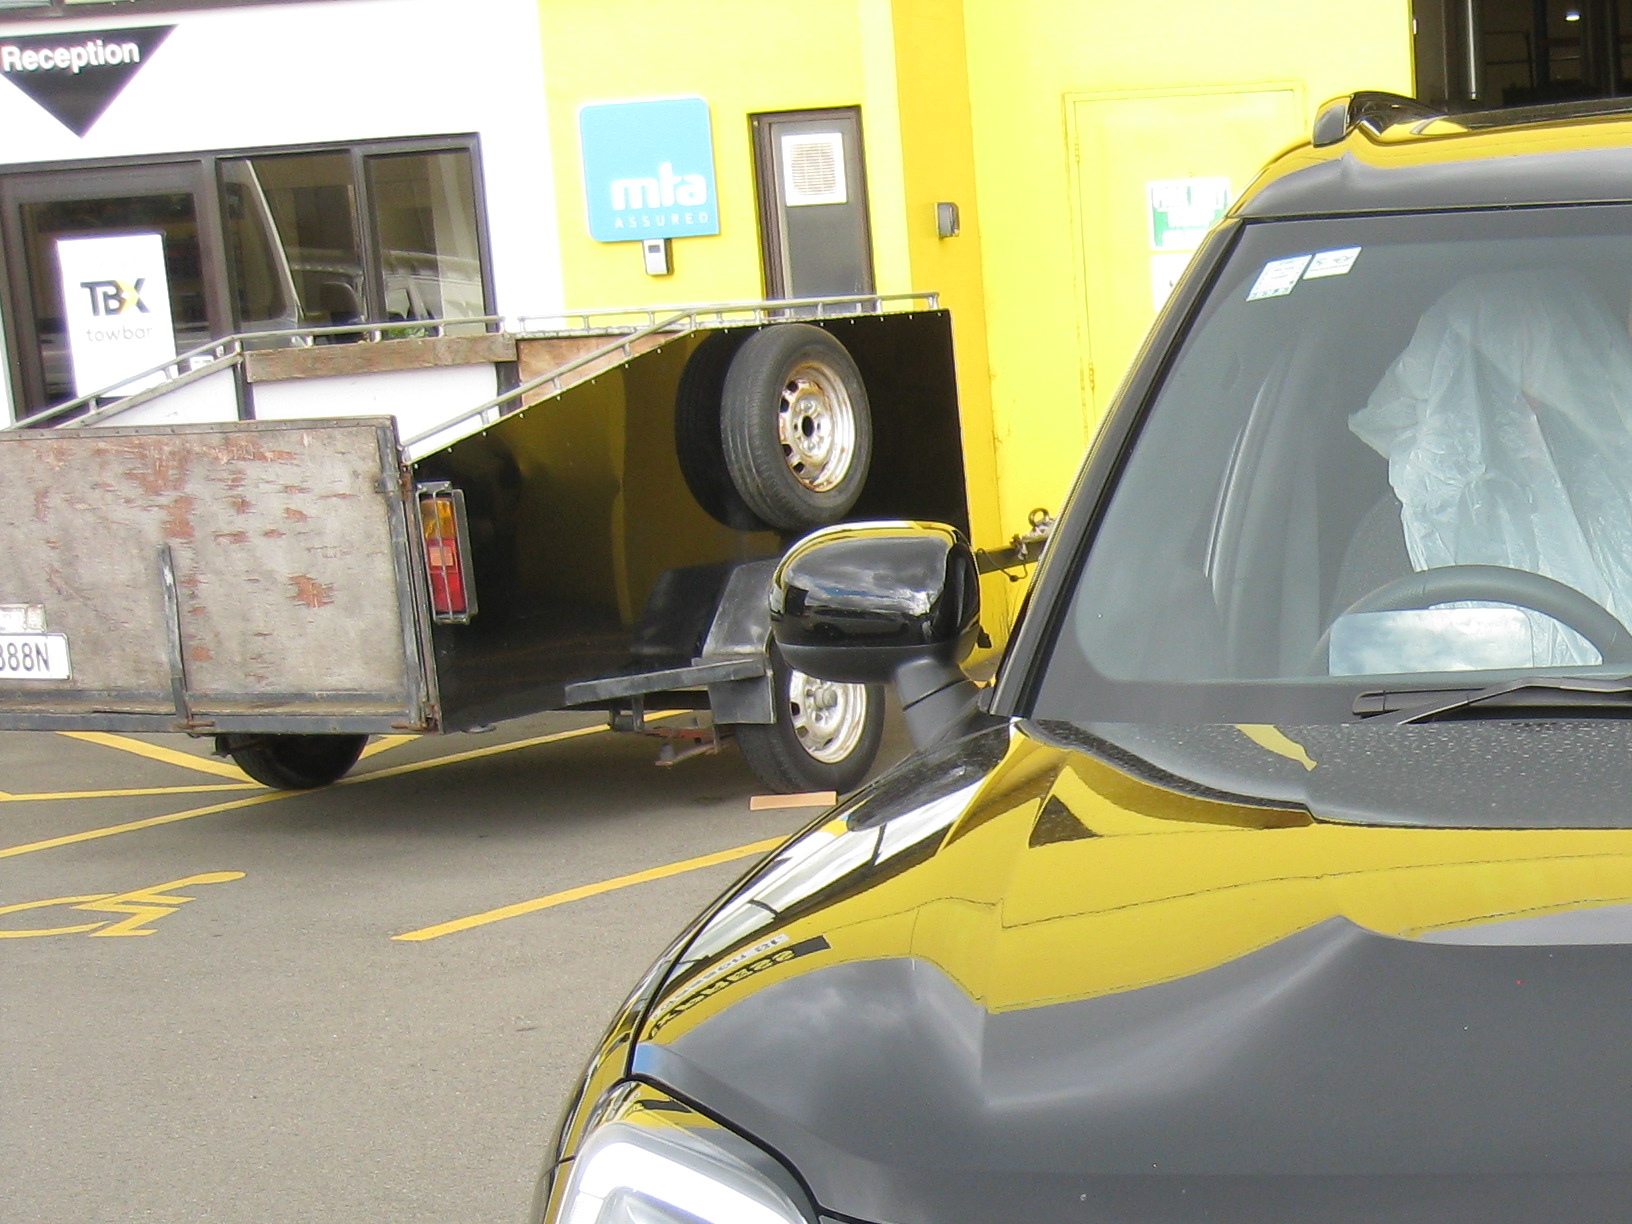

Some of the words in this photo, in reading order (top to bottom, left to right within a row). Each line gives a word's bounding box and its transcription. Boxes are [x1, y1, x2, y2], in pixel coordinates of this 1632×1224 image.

[1, 39, 140, 74] Reception
[611, 162, 707, 210] mta
[614, 211, 709, 229] ASSURED
[80, 278, 150, 316] TBX
[86, 325, 153, 342] towbar
